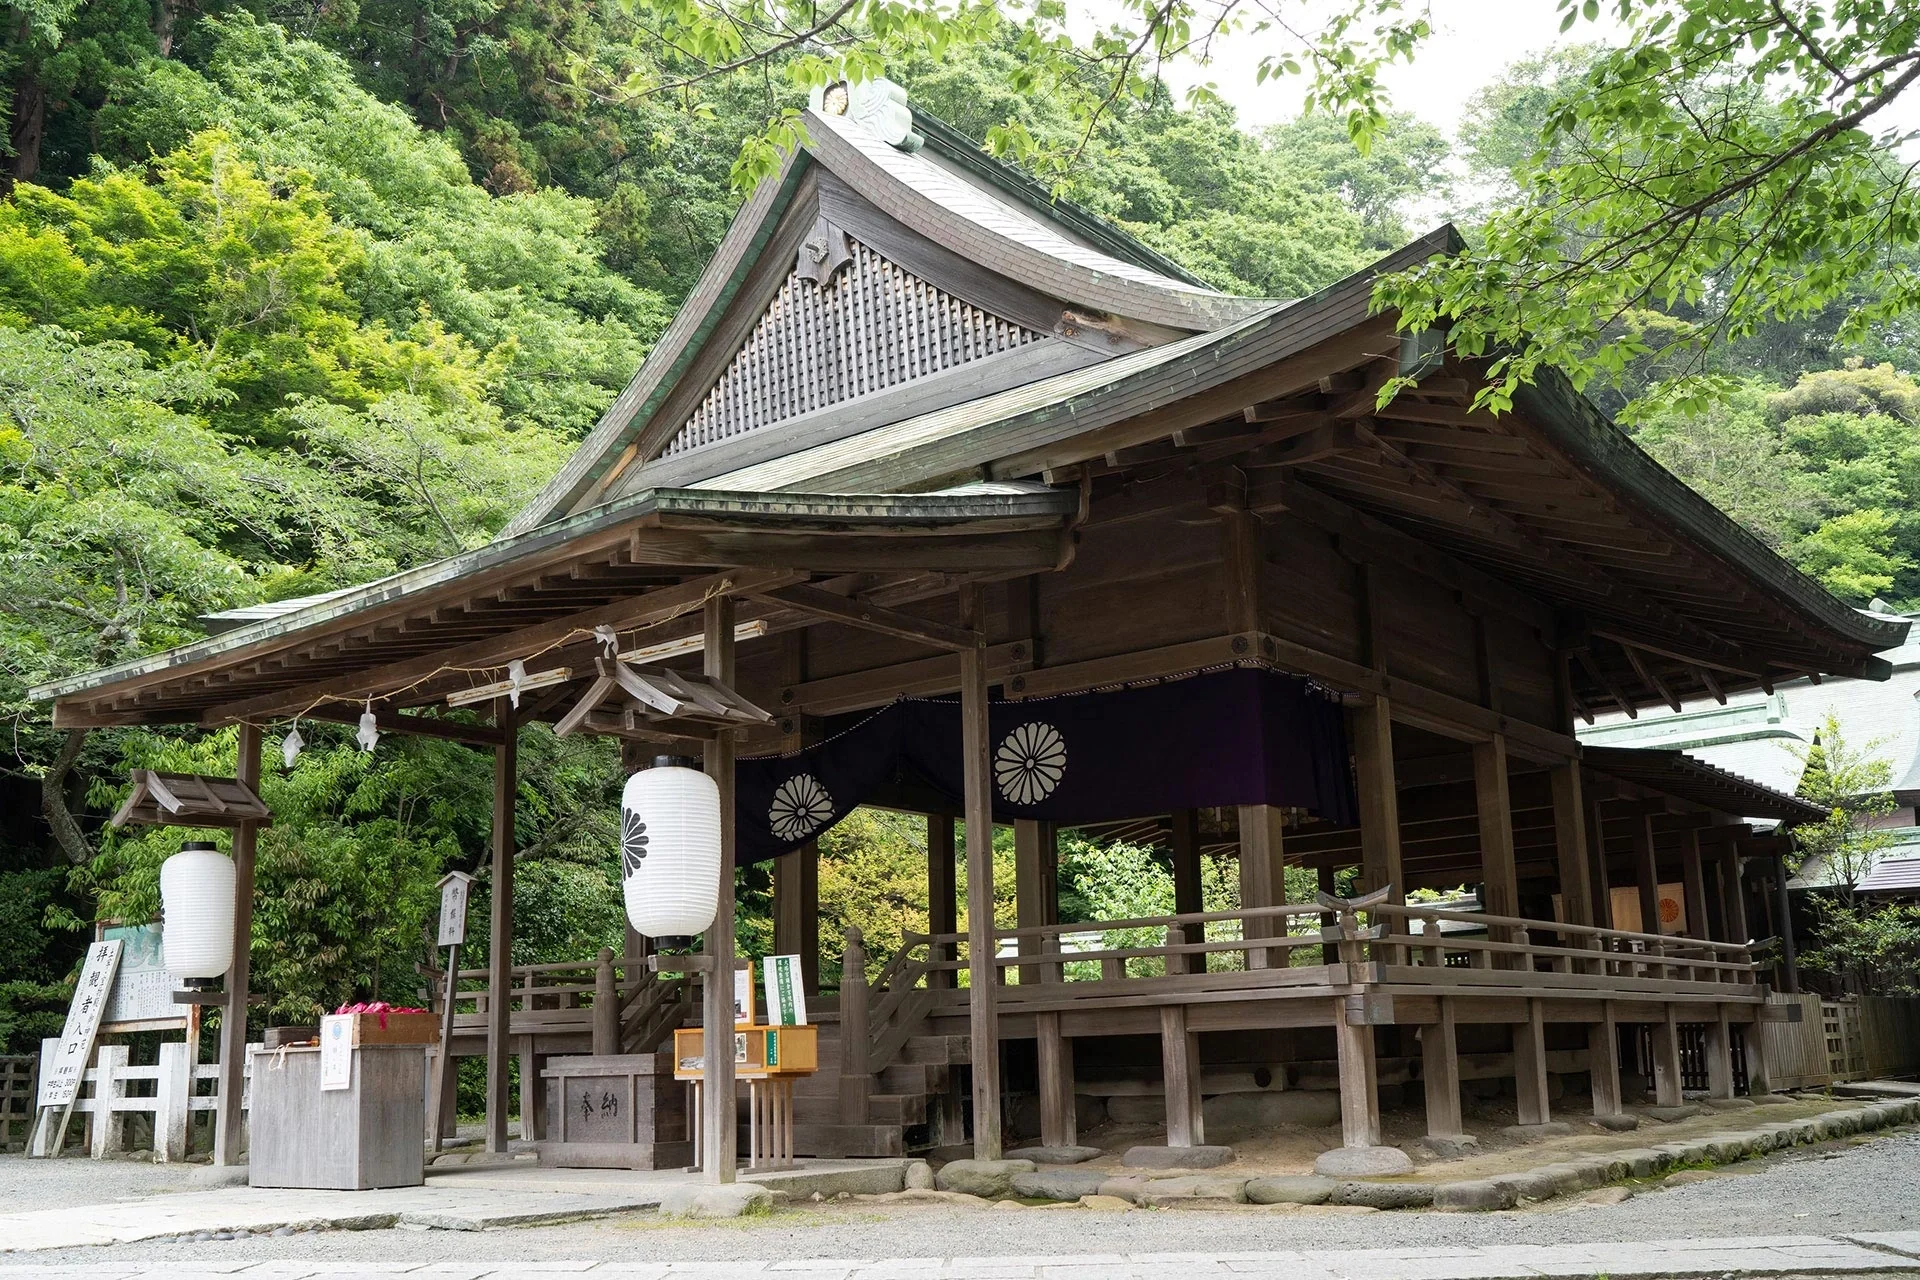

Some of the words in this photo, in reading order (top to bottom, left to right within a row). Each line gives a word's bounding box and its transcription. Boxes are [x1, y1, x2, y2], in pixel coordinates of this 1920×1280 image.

[67, 945, 109, 1055] 拝観者入口
